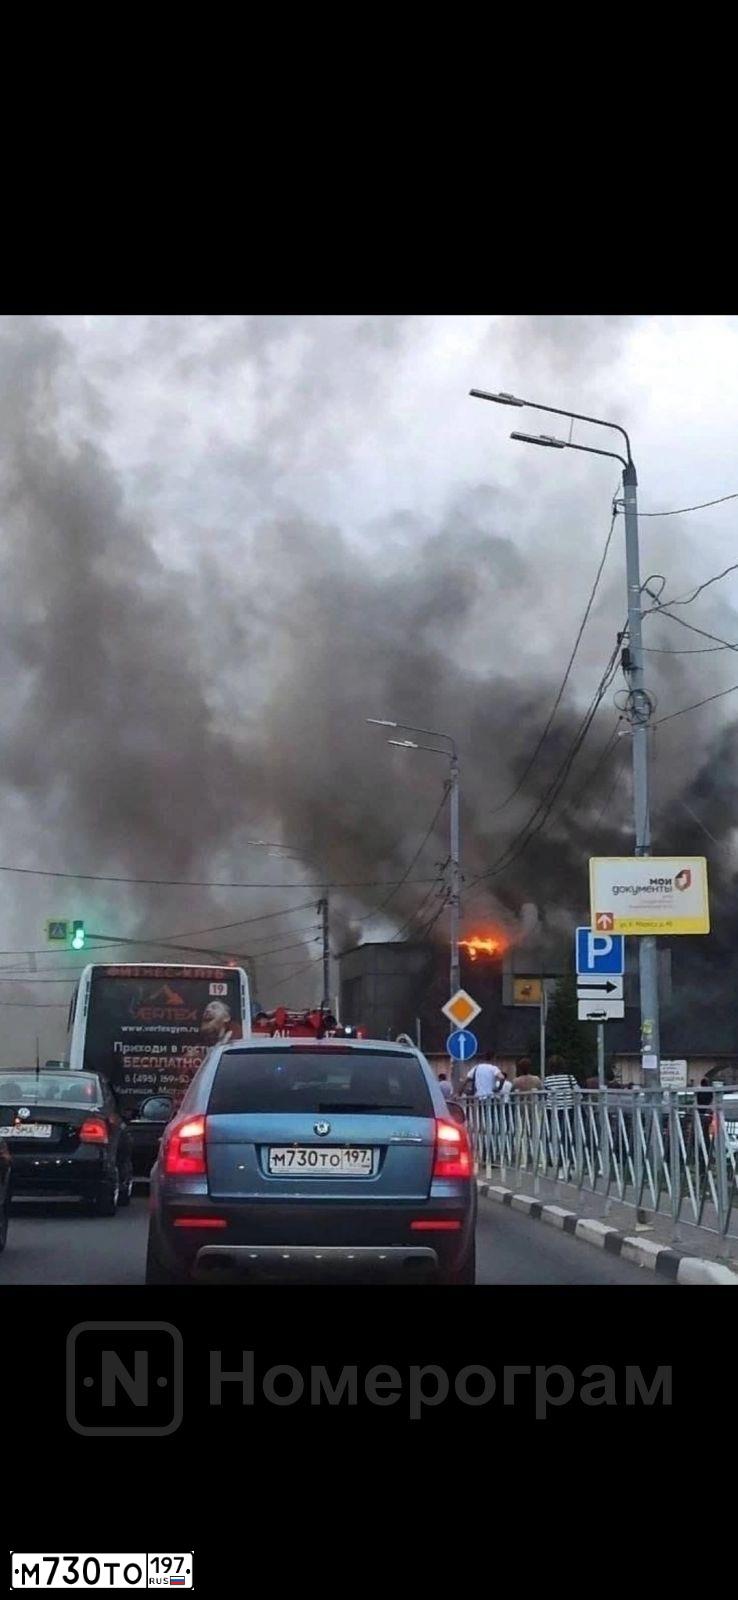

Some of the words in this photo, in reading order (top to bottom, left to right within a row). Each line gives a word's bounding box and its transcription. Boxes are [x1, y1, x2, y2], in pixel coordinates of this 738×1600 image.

[211, 984, 224, 994] 19
[132, 1007, 198, 1021] VERTEX
[121, 1025, 199, 1034] www.vertexgym.ru
[113, 1041, 167, 1055] Приходи
[171, 1045, 178, 1053] в
[123, 1056, 202, 1068] БЕСПЛАТНО
[132, 1073, 157, 1084] (495)
[273, 1150, 340, 1166] М730ТО
[344, 1150, 367, 1162] 197
